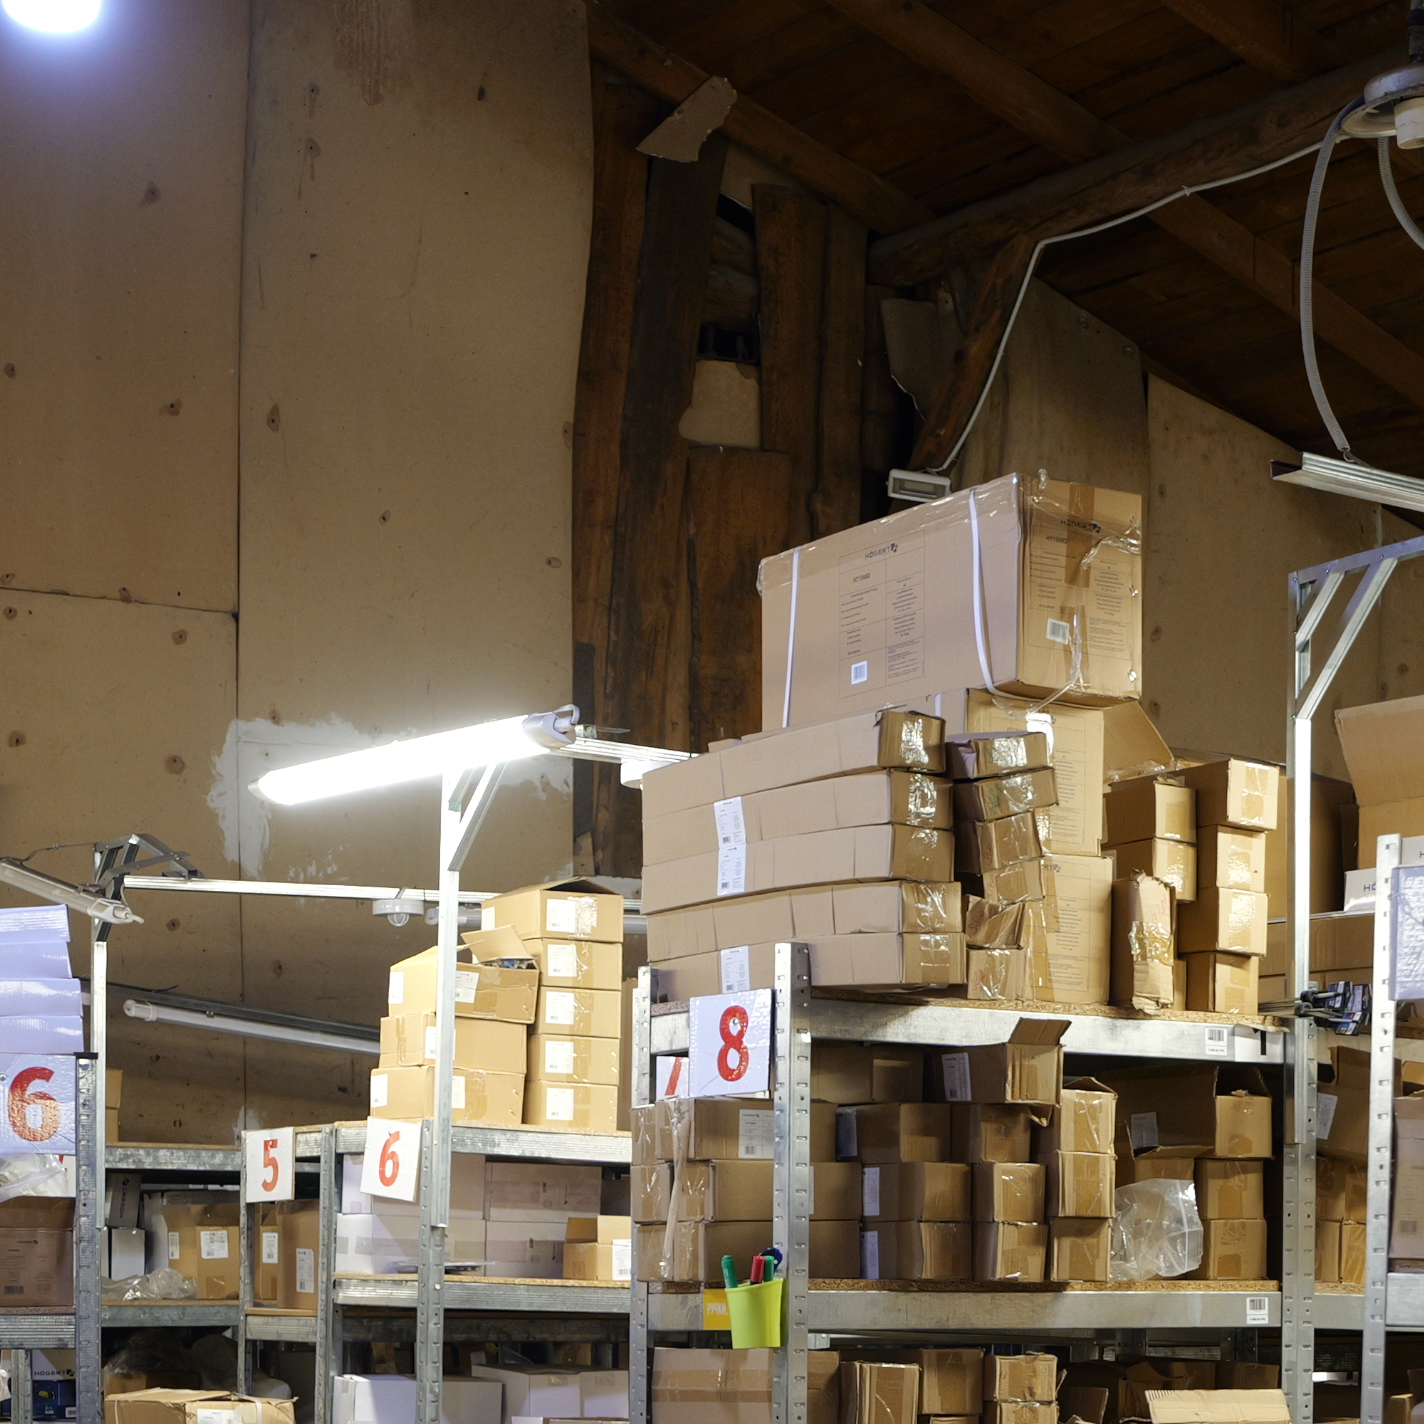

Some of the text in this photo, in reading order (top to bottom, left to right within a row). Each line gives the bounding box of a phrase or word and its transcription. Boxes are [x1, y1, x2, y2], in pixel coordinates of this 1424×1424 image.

[716, 1005, 750, 1082] 8
[261, 1139, 279, 1193] 5
[378, 1130, 401, 1187] 6
